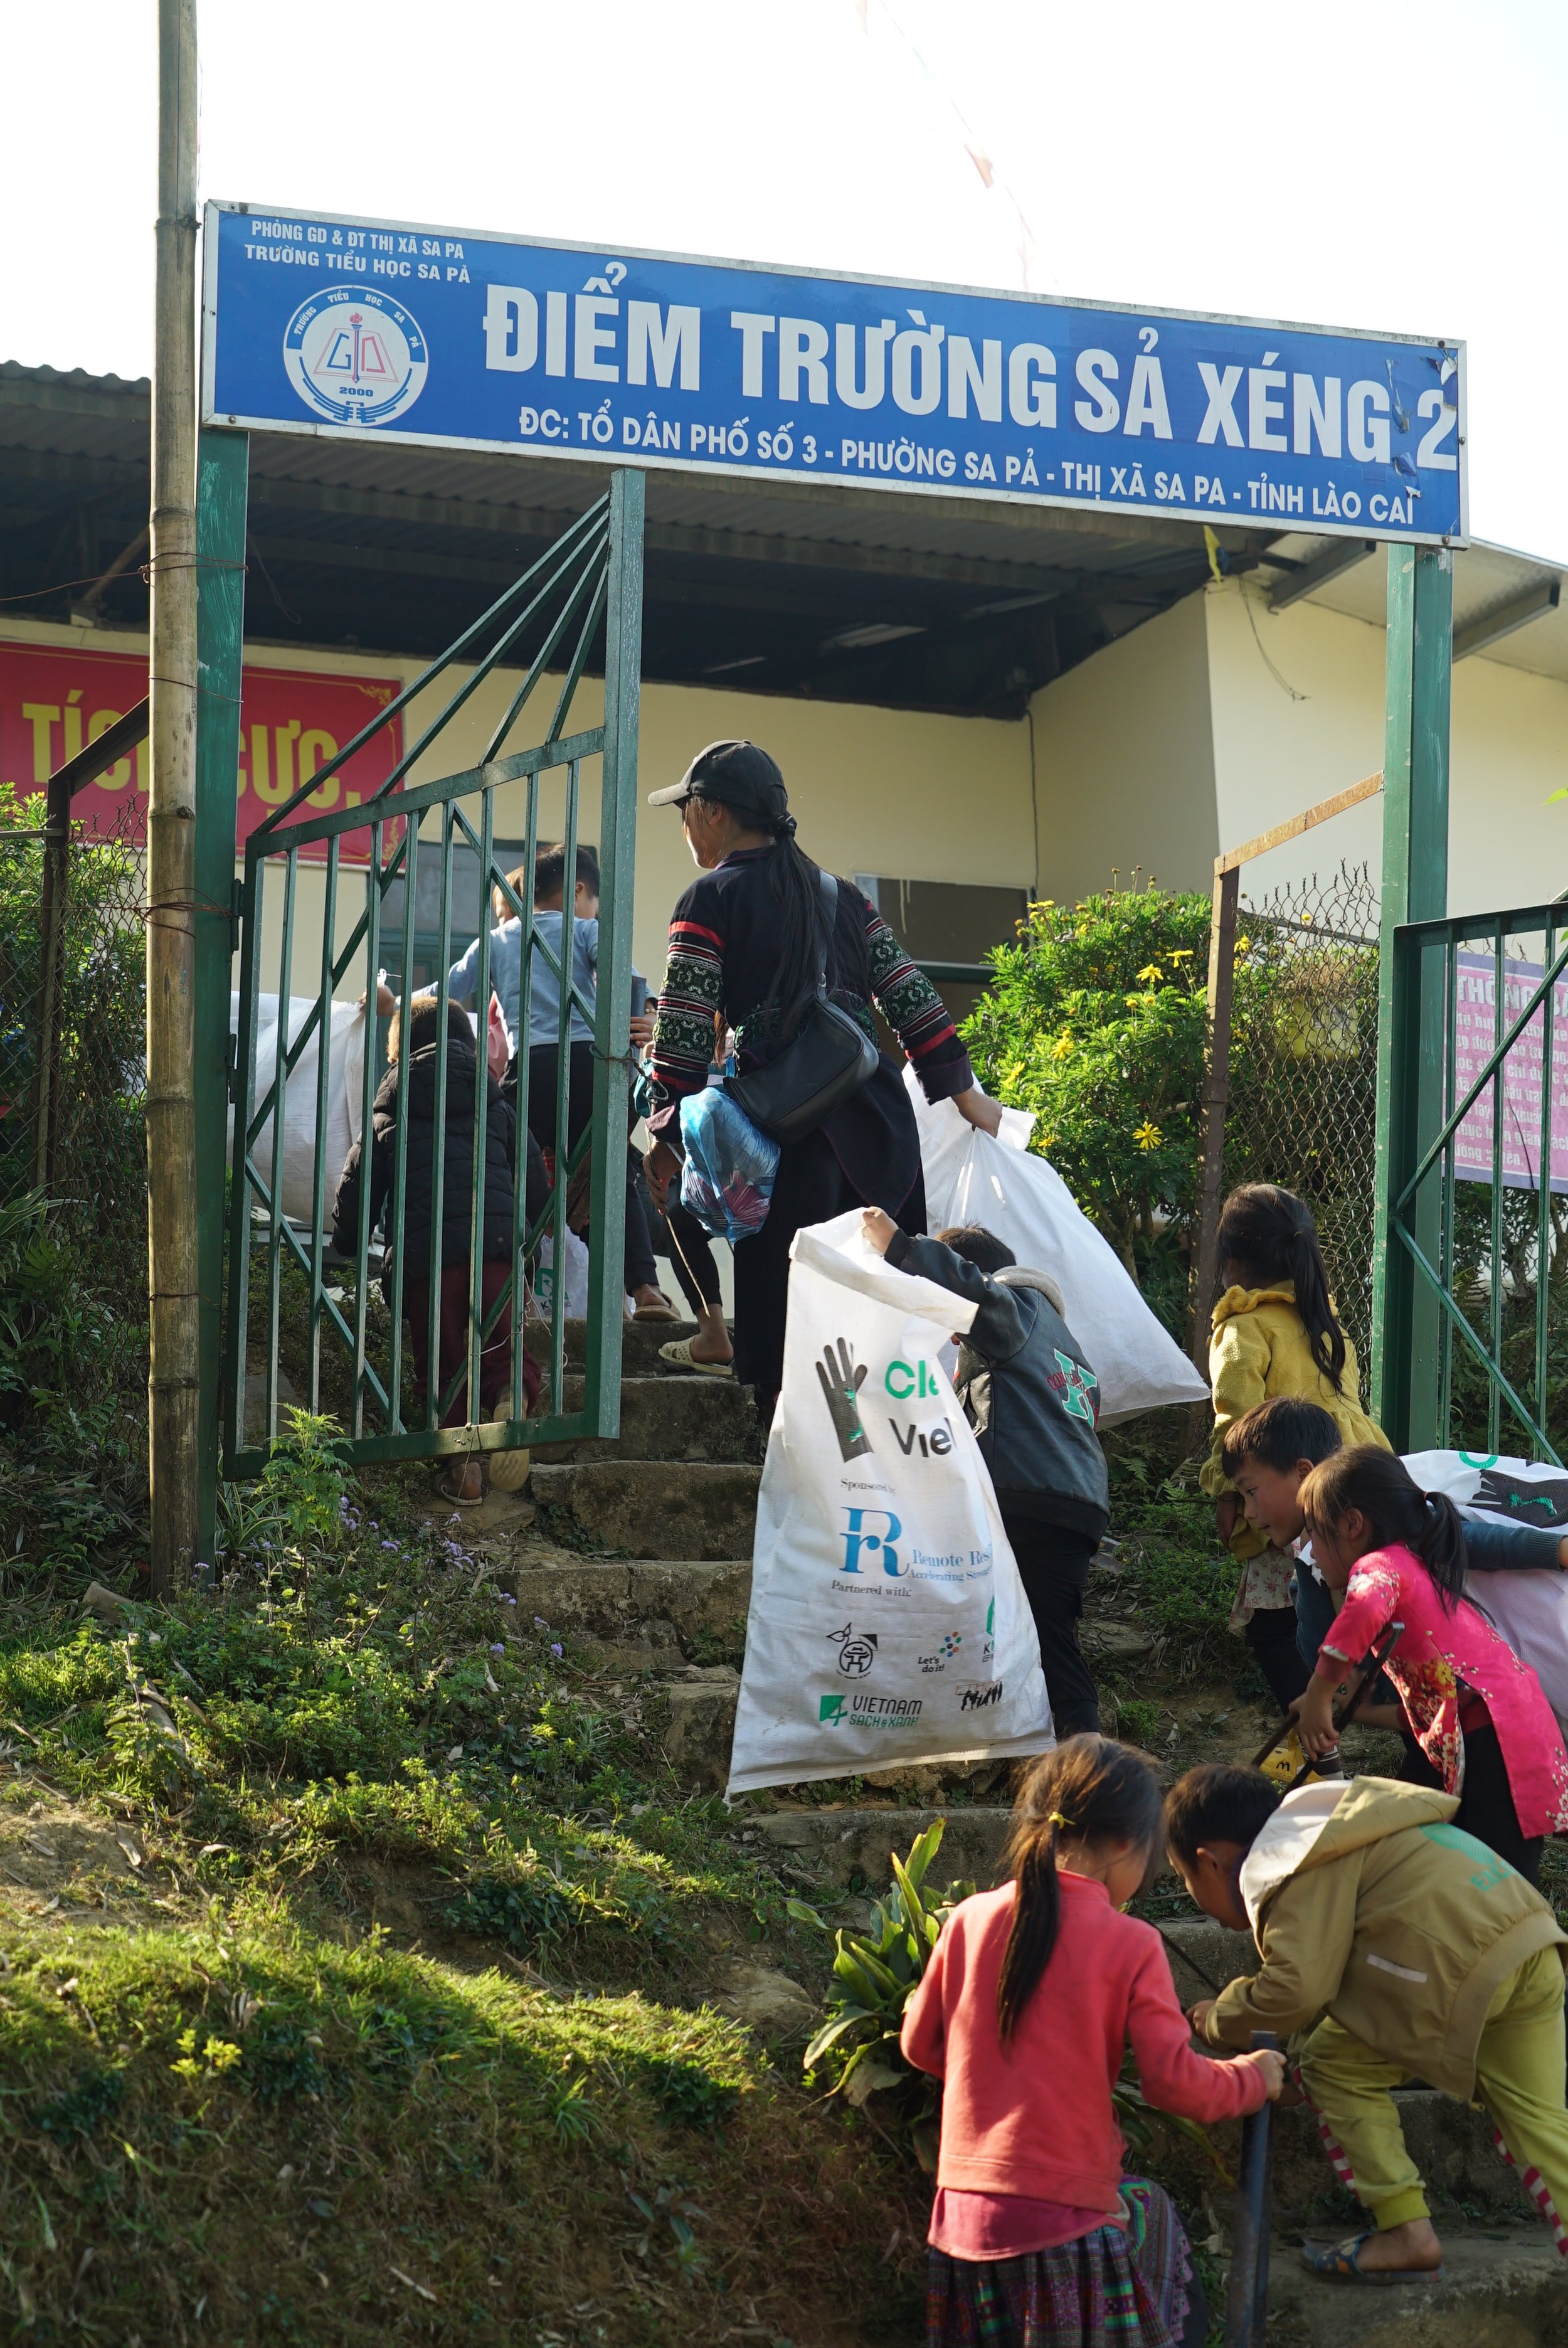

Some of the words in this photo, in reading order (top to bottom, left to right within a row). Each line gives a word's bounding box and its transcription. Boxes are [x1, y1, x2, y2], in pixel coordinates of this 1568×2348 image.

[252, 220, 302, 241] PHÒNG
[307, 226, 327, 243] GD
[332, 230, 342, 246] &
[347, 231, 367, 248] ĐT
[370, 233, 393, 255] THỊ
[398, 236, 418, 254] XÃ
[422, 240, 441, 257] SA
[445, 243, 464, 259] PA
[245, 244, 319, 267] TRƯỜNG
[326, 250, 366, 272] TIỂU
[373, 258, 411, 278] HỌC
[418, 263, 440, 280] SA
[447, 264, 470, 284] PẢ
[327, 290, 349, 303] TIỂU
[364, 294, 383, 307] HỌC
[393, 311, 406, 324] SA
[483, 261, 701, 391] ĐIỂM
[731, 308, 1057, 429] TRƯỜNG
[1074, 326, 1173, 440] SẢ
[1197, 351, 1391, 464] XÉNG
[1416, 388, 1457, 471] 2
[339, 386, 374, 397] 2000
[519, 406, 569, 438] ĐC:
[578, 398, 614, 443] TỔ
[623, 411, 681, 450] DÂN
[691, 416, 750, 457] PHỐ
[757, 421, 795, 461] SỐ
[802, 435, 817, 464] 3
[842, 437, 956, 477] PHƯỜNG
[965, 452, 997, 482] SA
[1006, 447, 1039, 486] PẢ
[1061, 462, 1101, 500] THỊ
[1110, 462, 1147, 497] XÃ
[1154, 471, 1186, 501] SA
[1195, 475, 1226, 506] PA
[1248, 472, 1303, 514] TỈNH
[1313, 481, 1362, 519] LÀO
[1369, 492, 1413, 524] CAI
[22, 689, 149, 792] TÍC
[912, 1549, 963, 1567] Remote
[831, 1580, 882, 1595] Partnered
[922, 1664, 934, 1672] do
[854, 1695, 922, 1715] VIETNAM
